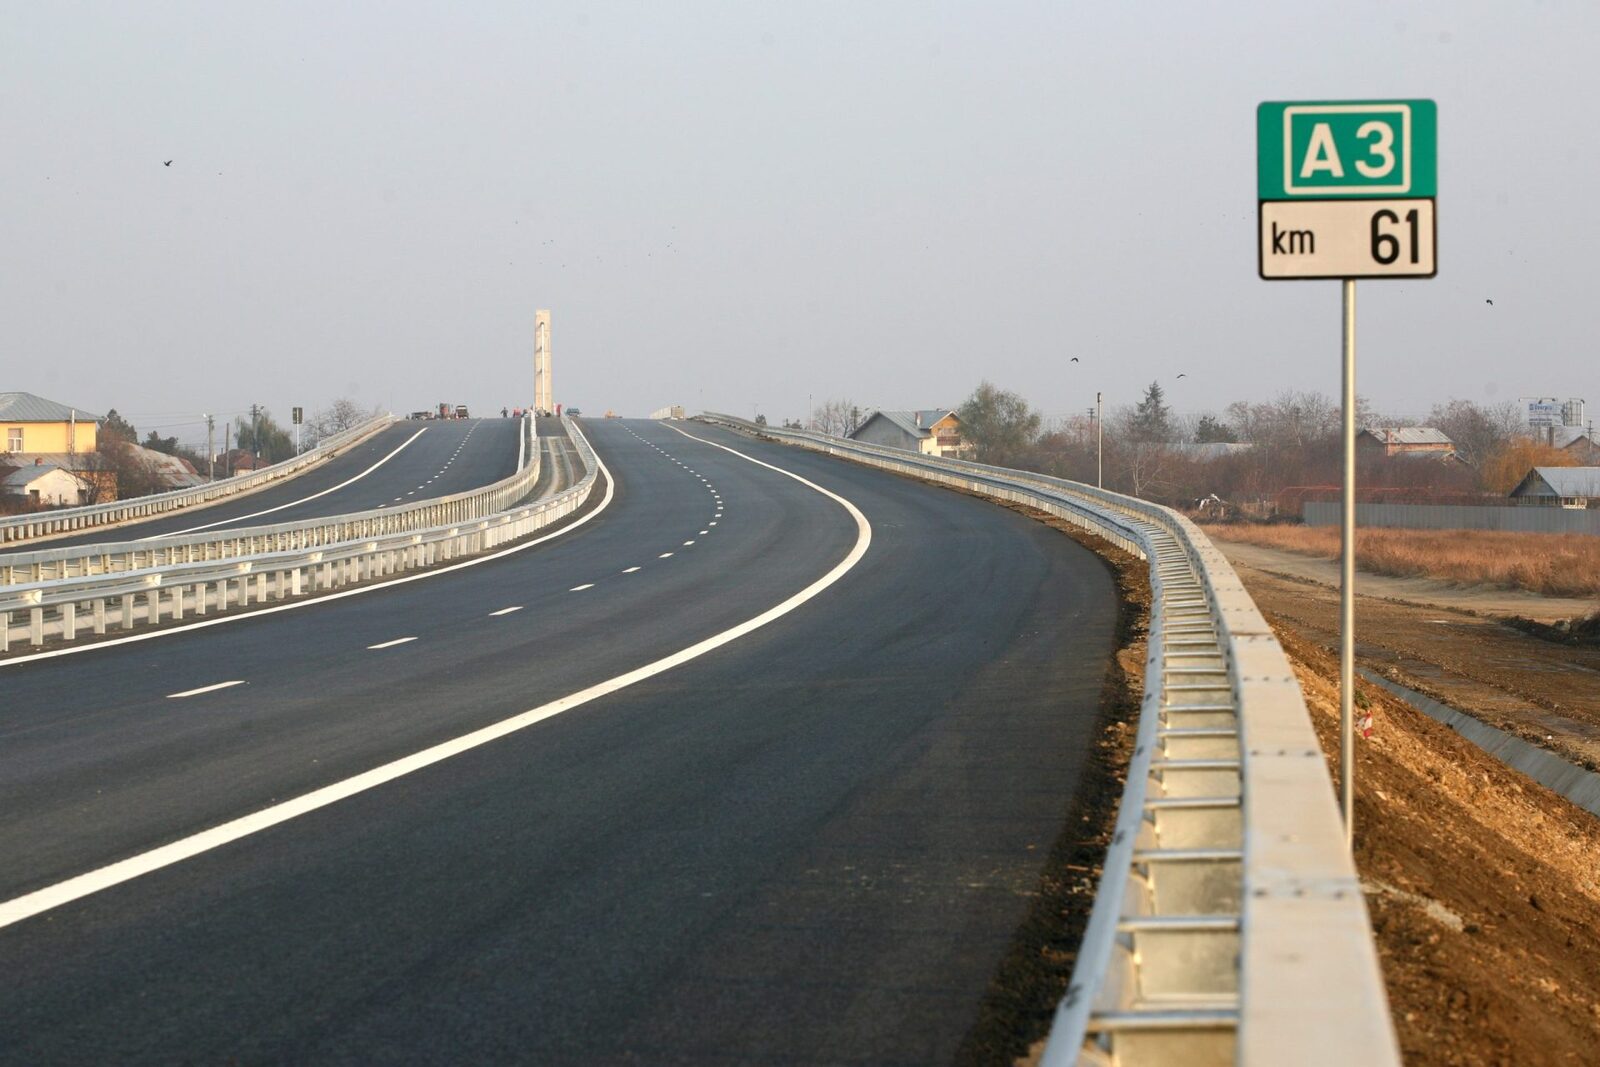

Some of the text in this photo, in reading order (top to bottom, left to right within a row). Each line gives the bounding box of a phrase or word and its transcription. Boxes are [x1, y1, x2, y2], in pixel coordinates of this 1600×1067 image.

[1300, 120, 1396, 179] A 3
[1271, 208, 1419, 265] km 61
